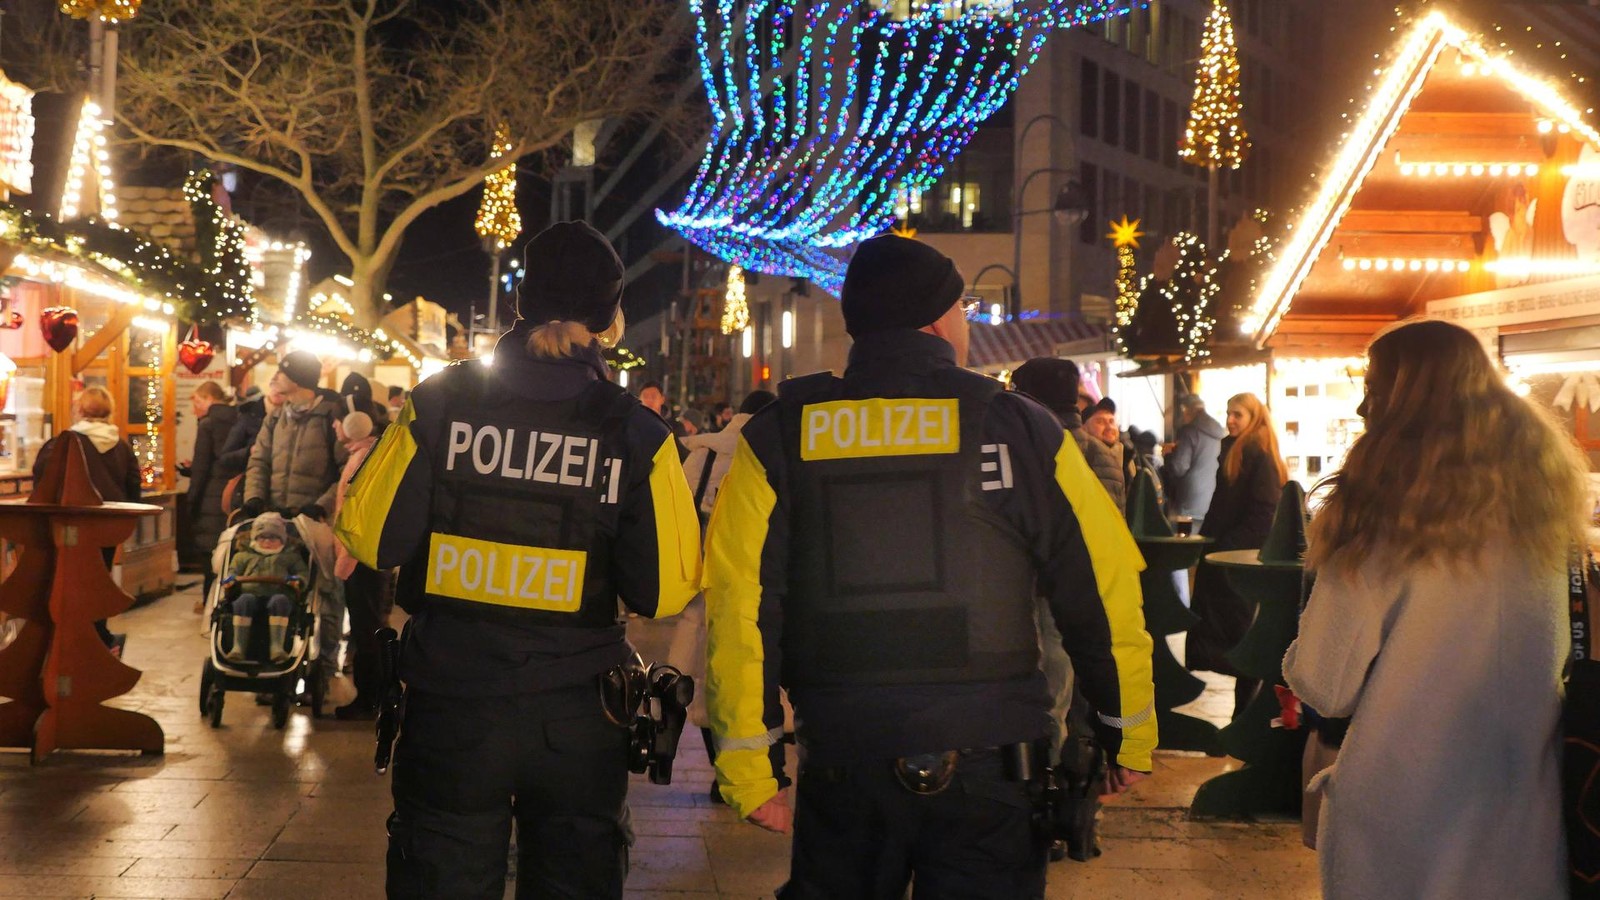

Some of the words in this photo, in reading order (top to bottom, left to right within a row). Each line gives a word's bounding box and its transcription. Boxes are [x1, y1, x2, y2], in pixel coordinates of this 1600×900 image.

[808, 405, 949, 450] POLIZEI
[446, 421, 598, 487] POLIZEI
[435, 543, 577, 602] POLIZEI
[1572, 622, 1584, 639] US
